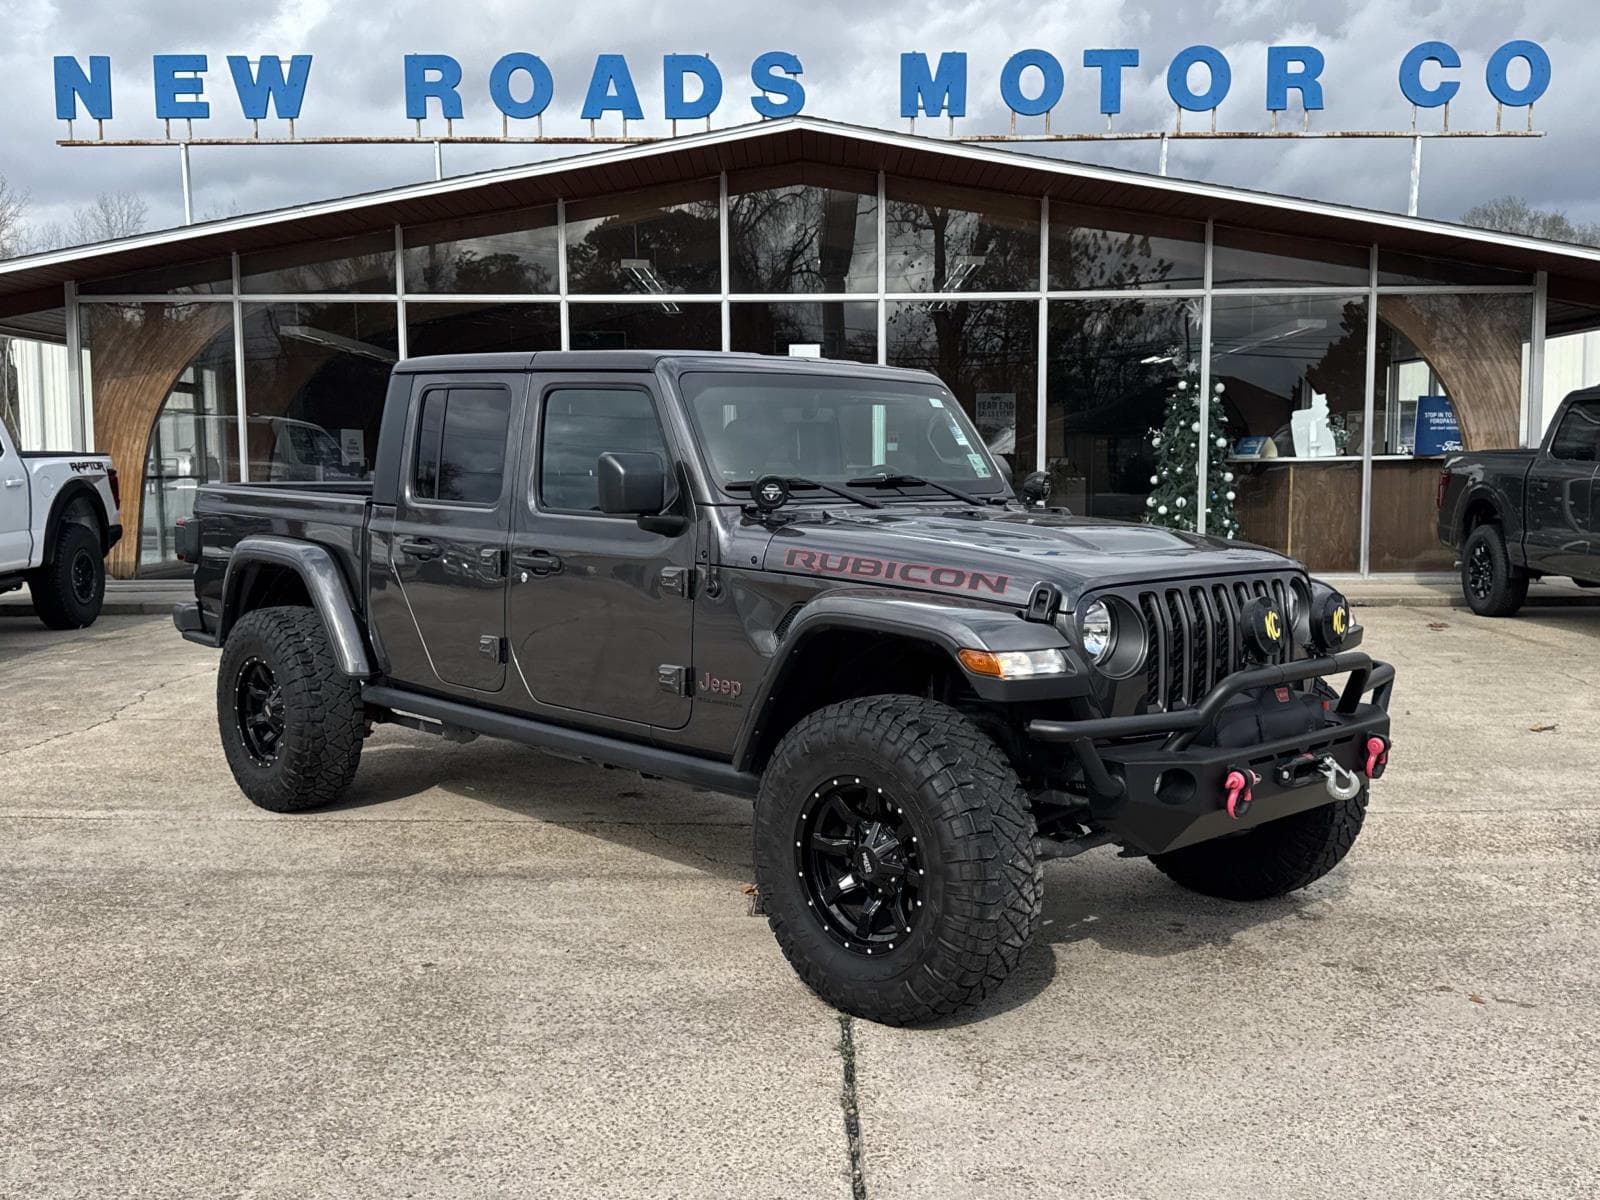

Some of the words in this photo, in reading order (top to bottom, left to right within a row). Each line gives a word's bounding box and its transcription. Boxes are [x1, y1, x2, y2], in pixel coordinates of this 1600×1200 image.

[54, 54, 311, 119] NEW
[404, 52, 806, 119] ROADS
[901, 45, 1324, 117] MOTOR
[1399, 40, 1551, 107] CO
[69, 461, 106, 473] RAPTOR
[784, 547, 1010, 595] RUBICON
[1264, 610, 1281, 641] KC
[1333, 606, 1346, 635] KC
[698, 672, 742, 699] Jeep
